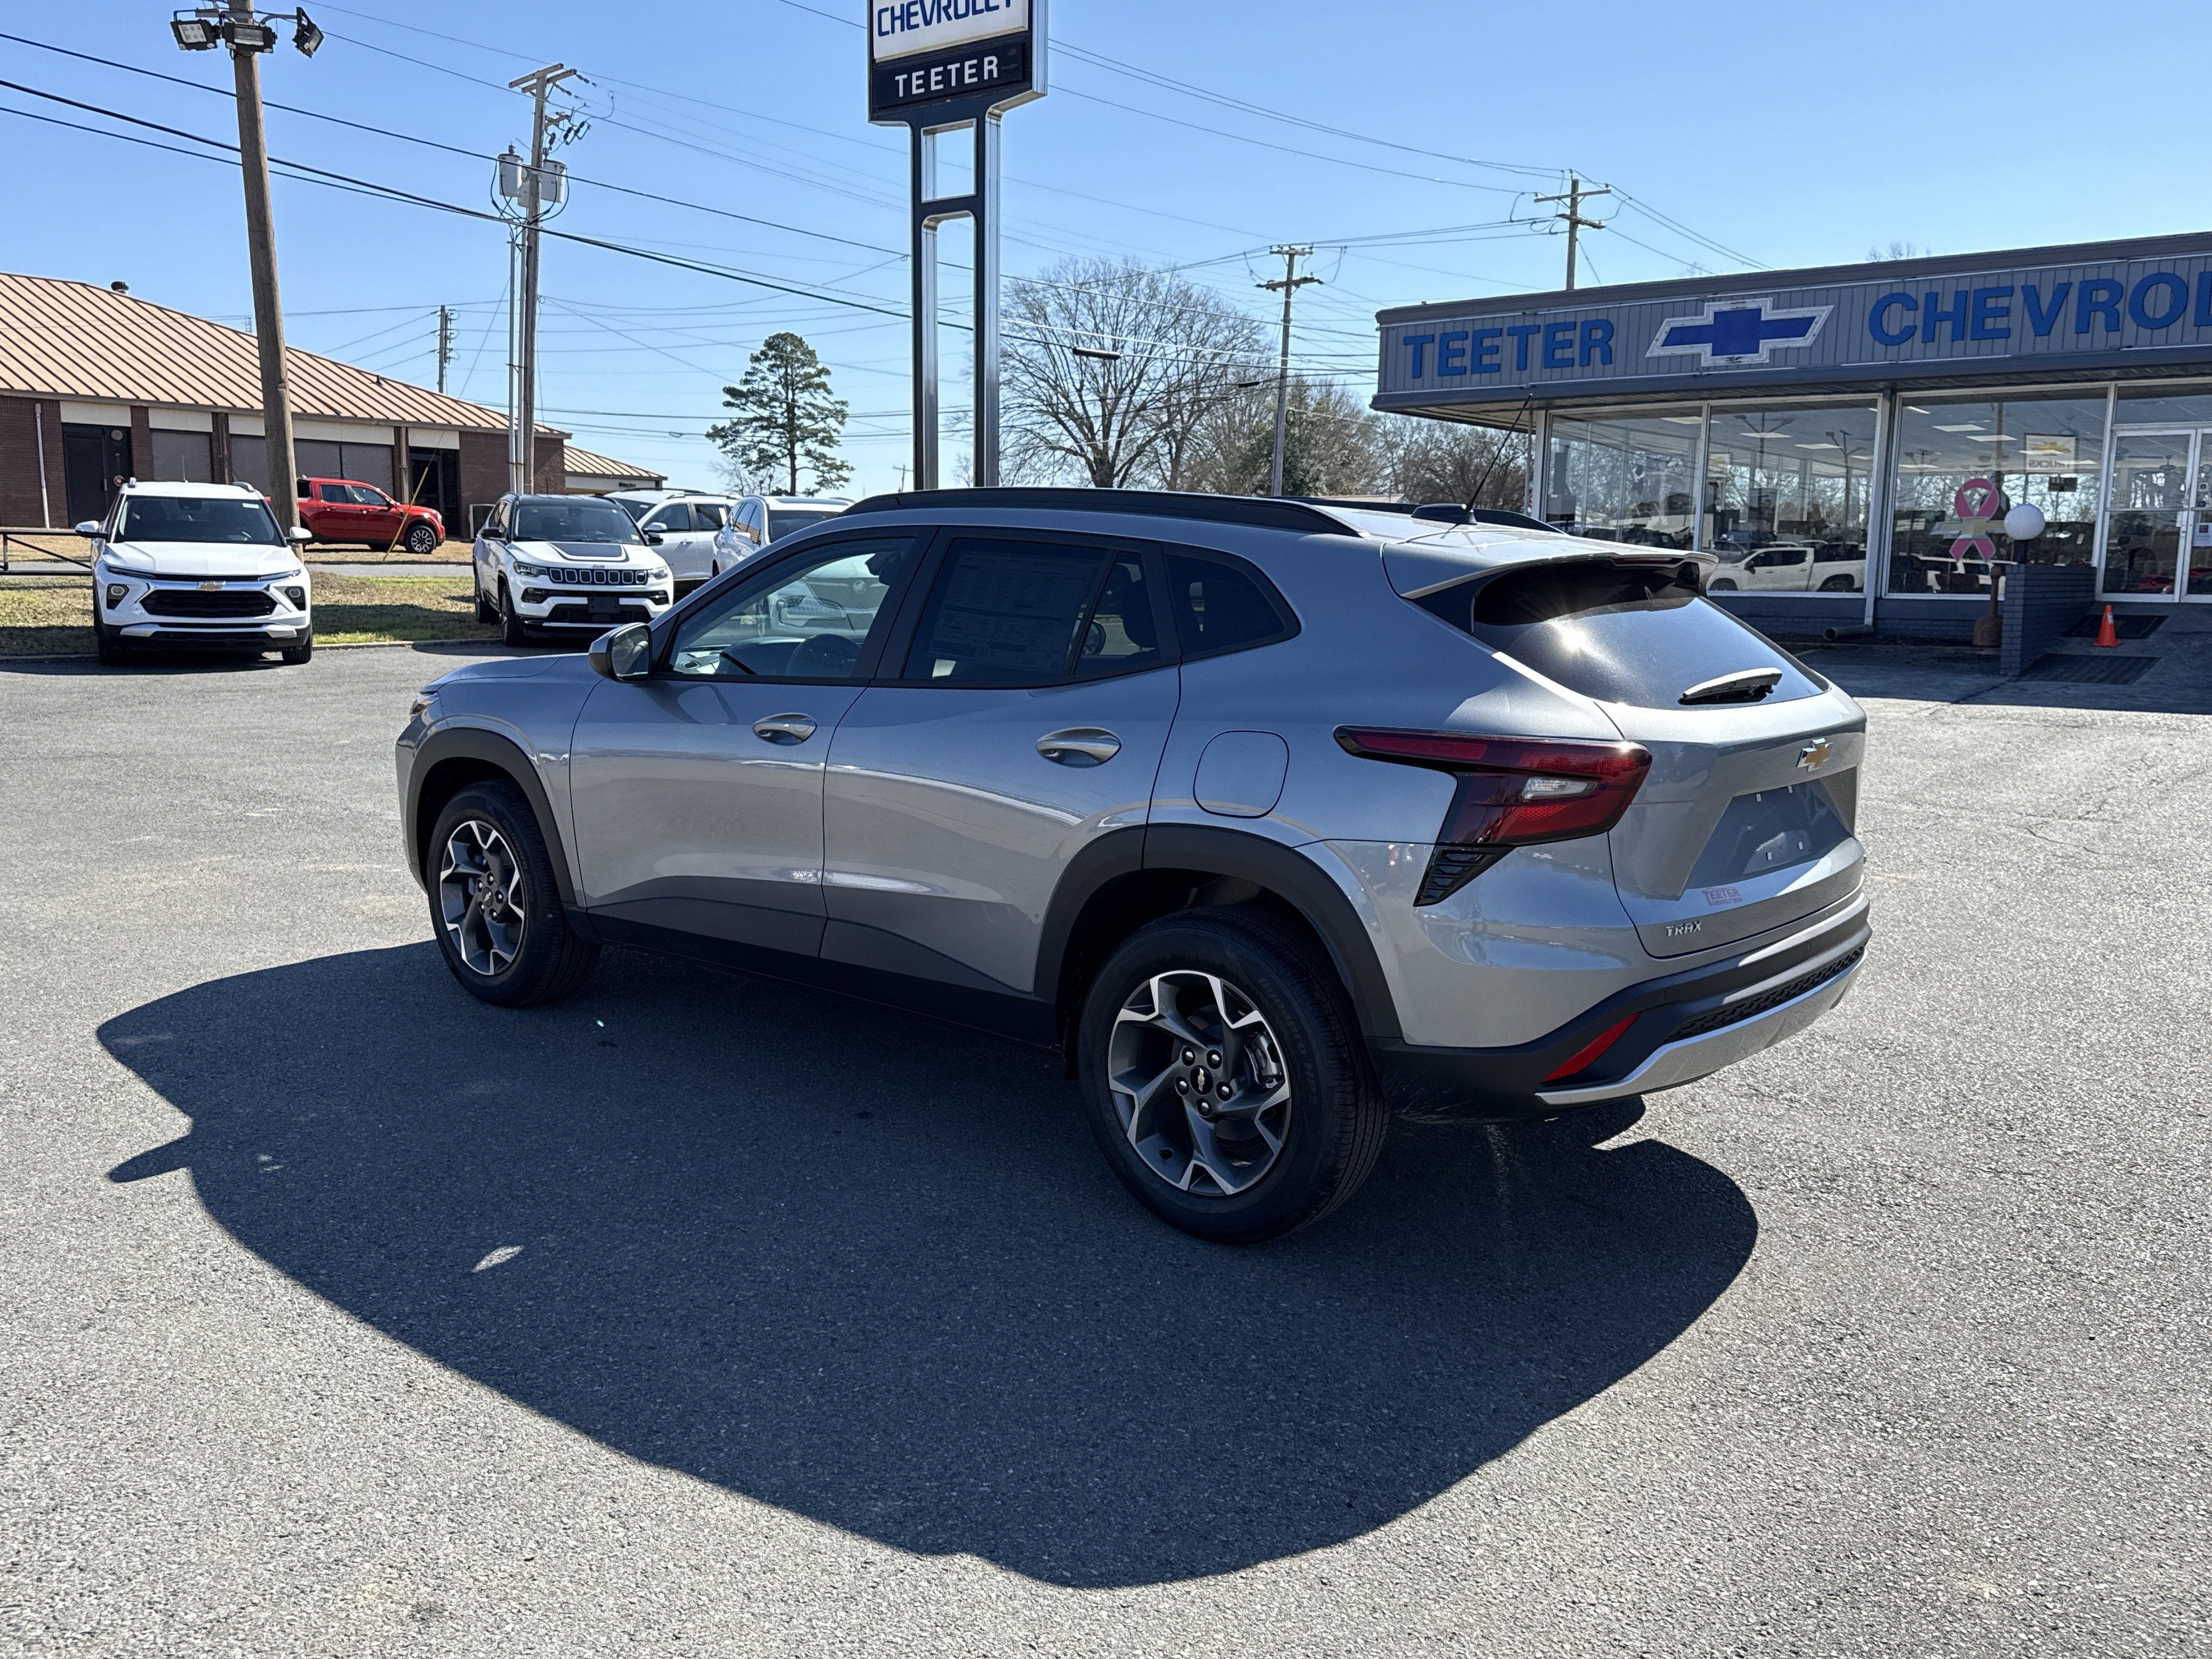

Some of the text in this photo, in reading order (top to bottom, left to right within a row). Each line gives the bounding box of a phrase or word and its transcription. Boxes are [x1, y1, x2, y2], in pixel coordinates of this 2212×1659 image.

[877, 0, 1011, 37] CHEVROL
[894, 55, 998, 98] TEETER
[1403, 319, 1614, 379] TEETER
[1702, 887, 1740, 906] TEETER
[1665, 920, 1702, 936] TRAX
